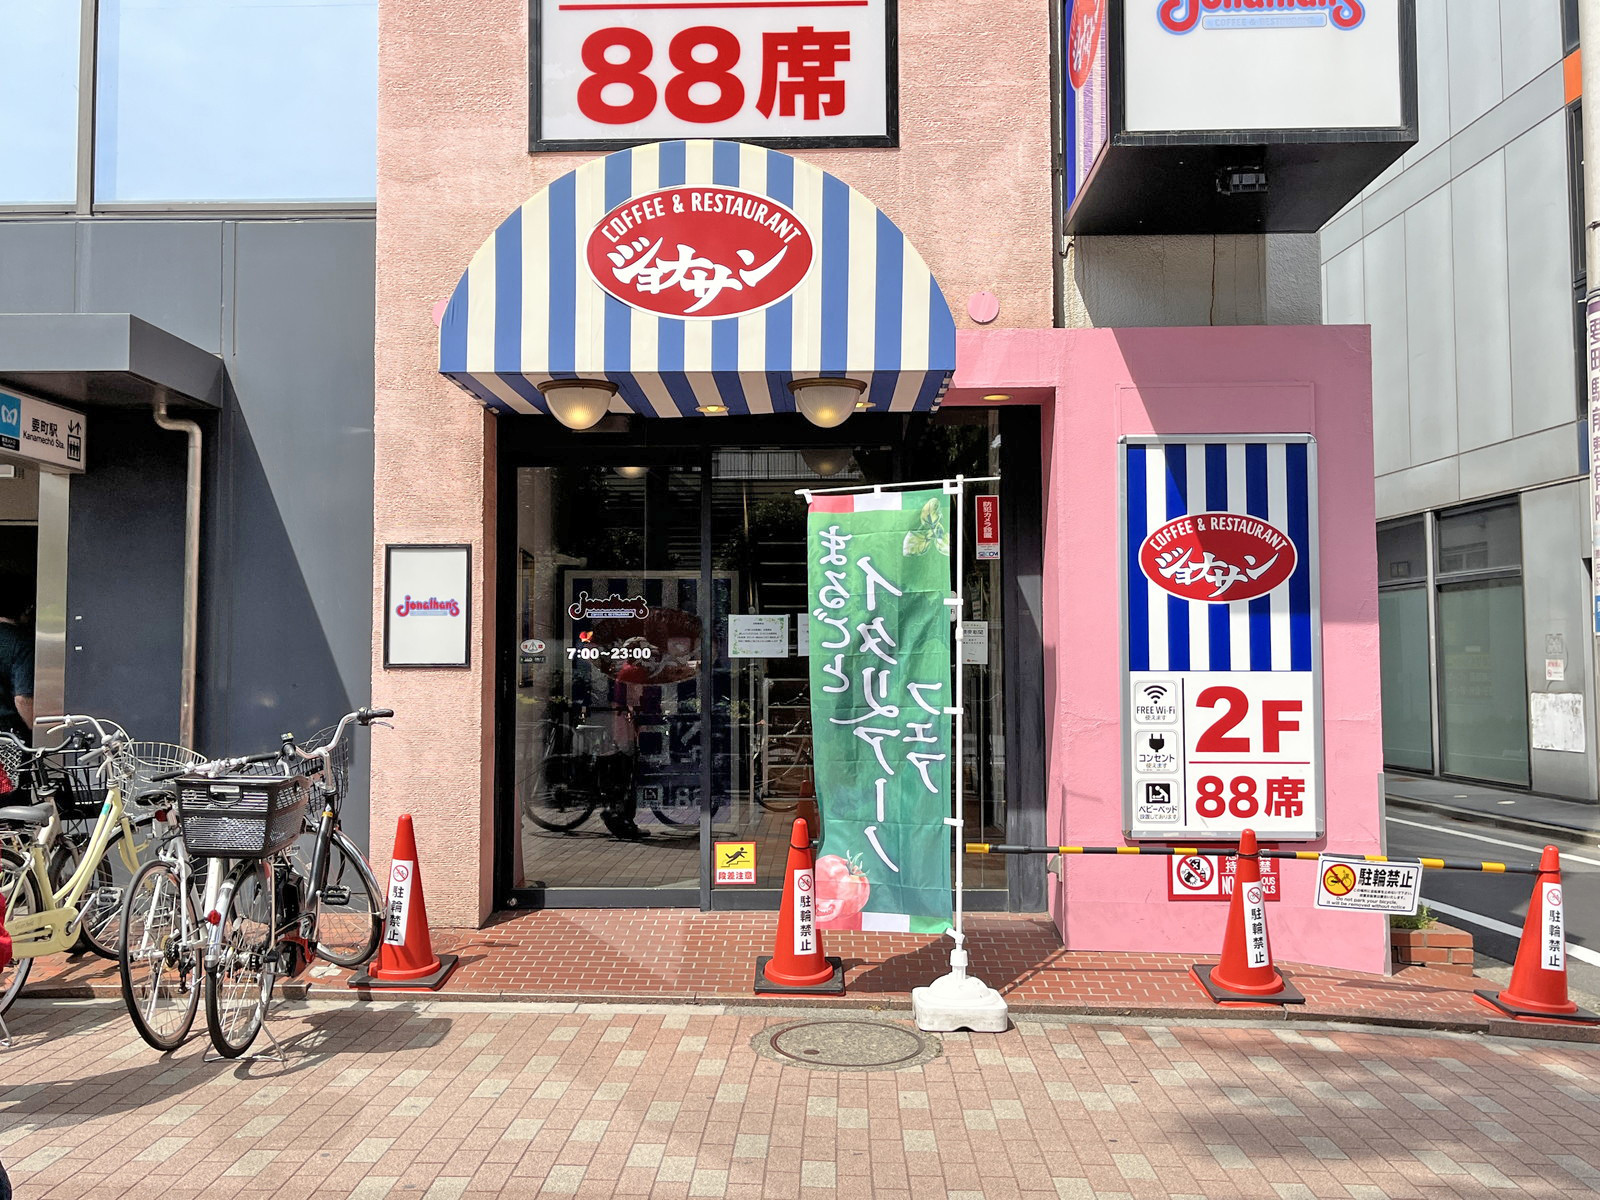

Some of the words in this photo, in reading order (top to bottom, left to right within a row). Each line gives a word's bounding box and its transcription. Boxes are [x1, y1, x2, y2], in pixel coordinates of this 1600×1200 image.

[577, 25, 851, 125] 88席
[600, 196, 666, 242] COFFEE
[672, 194, 685, 214] &
[690, 192, 802, 244] RESTAURANT
[606, 236, 789, 314] ジョナサン
[32, 418, 58, 438] 要町駅
[56, 438, 65, 449] Sta.
[982, 501, 993, 539] 防犯カメラ設置
[1150, 519, 1194, 552] COFFEE
[1197, 518, 1206, 532] &
[1210, 516, 1288, 551] RESTAURANT
[1154, 547, 1280, 598] ジョナサン
[1136, 706, 1154, 714] FREE
[1195, 686, 1302, 753] 2F
[1139, 754, 1175, 762] コンセント
[1138, 805, 1178, 814] ベビーベッド
[1196, 775, 1306, 818] 88席
[718, 872, 752, 880] 段差注意
[1358, 868, 1413, 888] 駐輪禁止
[388, 886, 404, 942] 駐輪禁止
[800, 894, 812, 952] 駐輪禁止
[1250, 908, 1266, 964] 駐輪禁止
[1549, 910, 1561, 967] 駐輪禁止
